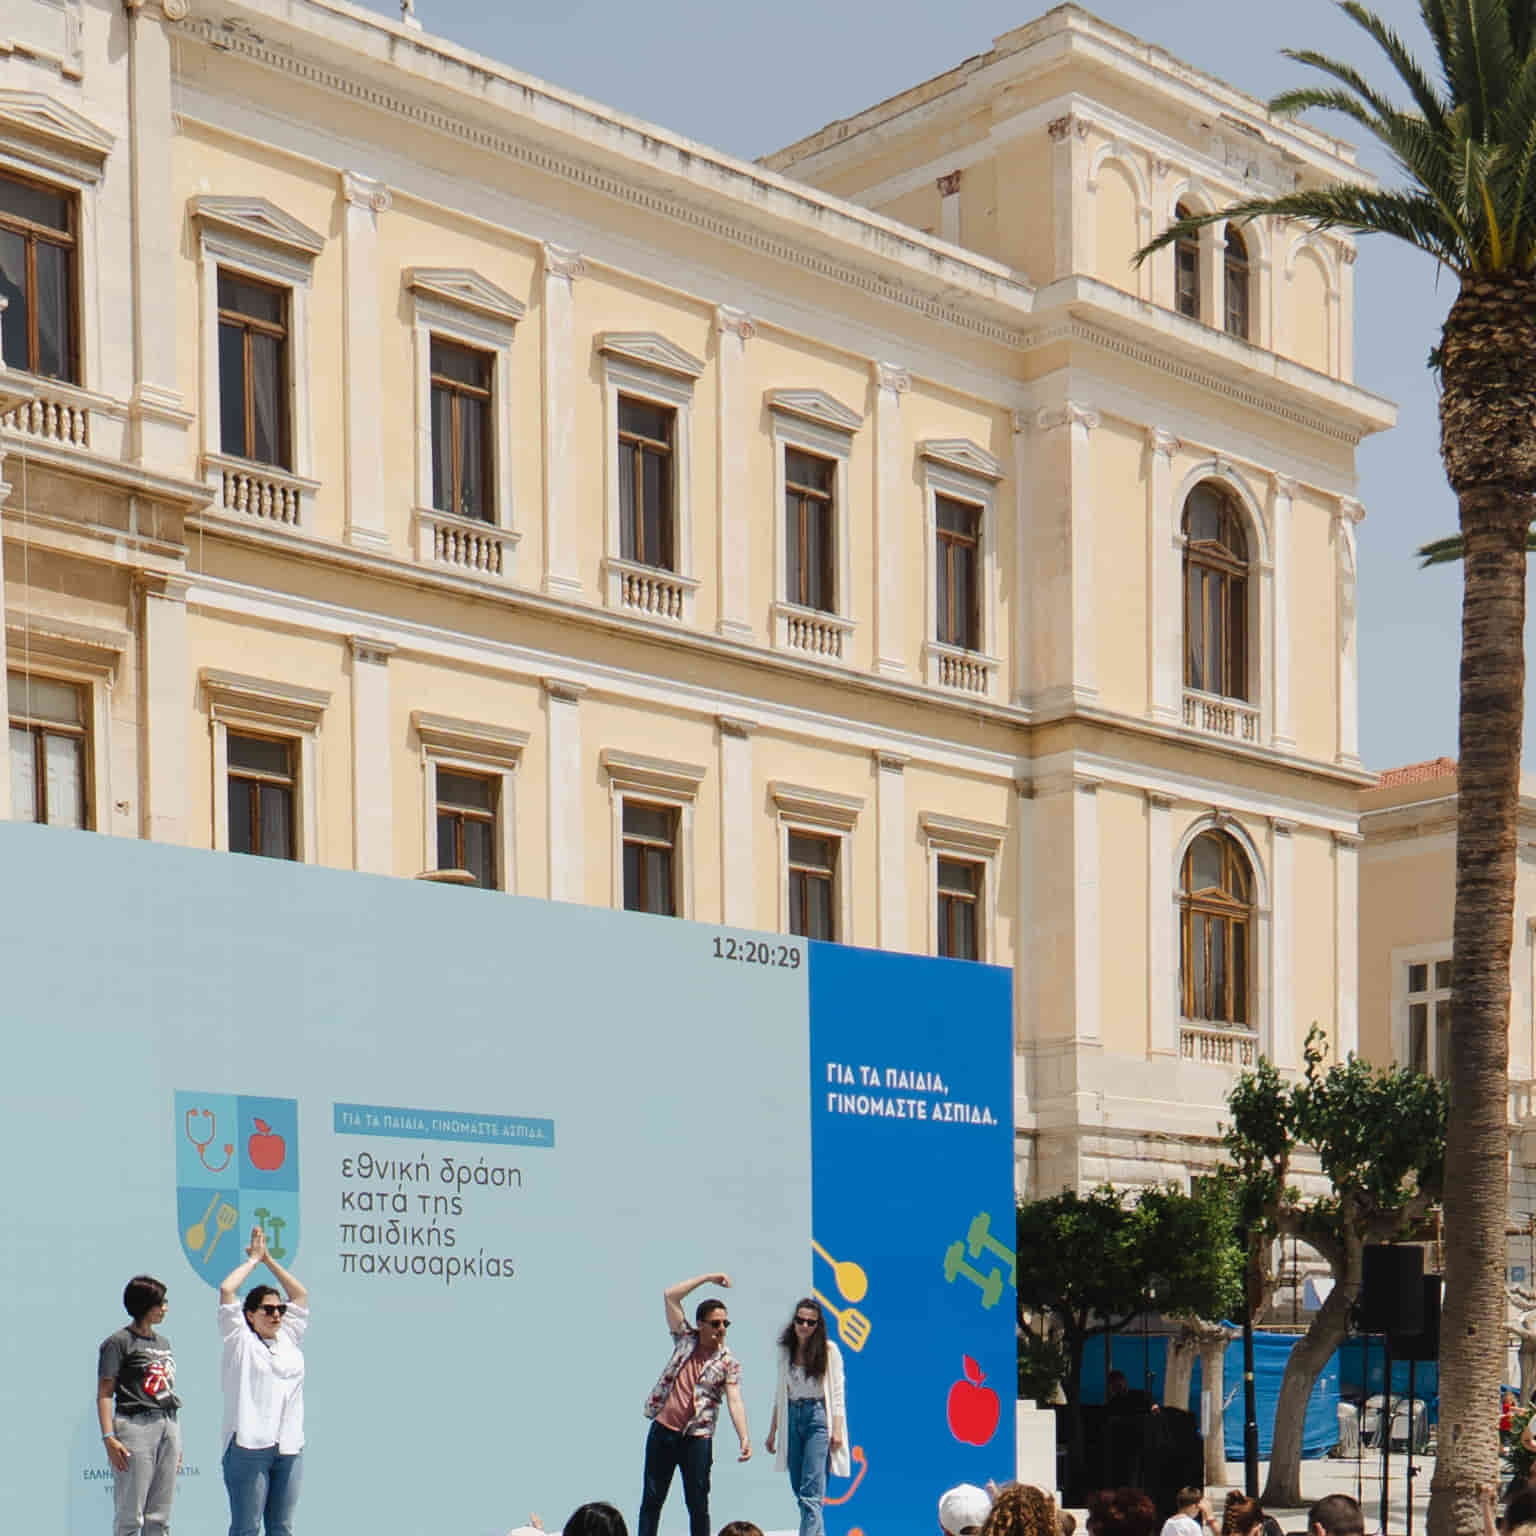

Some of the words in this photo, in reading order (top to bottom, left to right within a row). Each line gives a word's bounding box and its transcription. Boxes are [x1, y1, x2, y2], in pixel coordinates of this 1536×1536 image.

[713, 936, 801, 969] 12:20:29
[826, 1063, 855, 1085] ΓΙΑ
[859, 1066, 881, 1087] ΤΑ
[885, 1068, 949, 1096] ΠΑΙΔΙΑ,
[343, 1111, 361, 1126] ΓΙΑ
[366, 1114, 381, 1128] ΤΑ
[432, 1119, 498, 1137] ΓΙΝΟΜΑΣΤΕ
[826, 1093, 928, 1120] ΓΙΝΟΜΑΣΤΕ
[931, 1102, 999, 1127] ΑΣΠΙΔΑ.
[341, 1152, 430, 1182] εθνική
[439, 1156, 522, 1192] δράση
[341, 1184, 408, 1213] κατά
[417, 1195, 464, 1216] της
[339, 1218, 457, 1247] παιδικής
[339, 1248, 515, 1285] παχυσαρκίας
